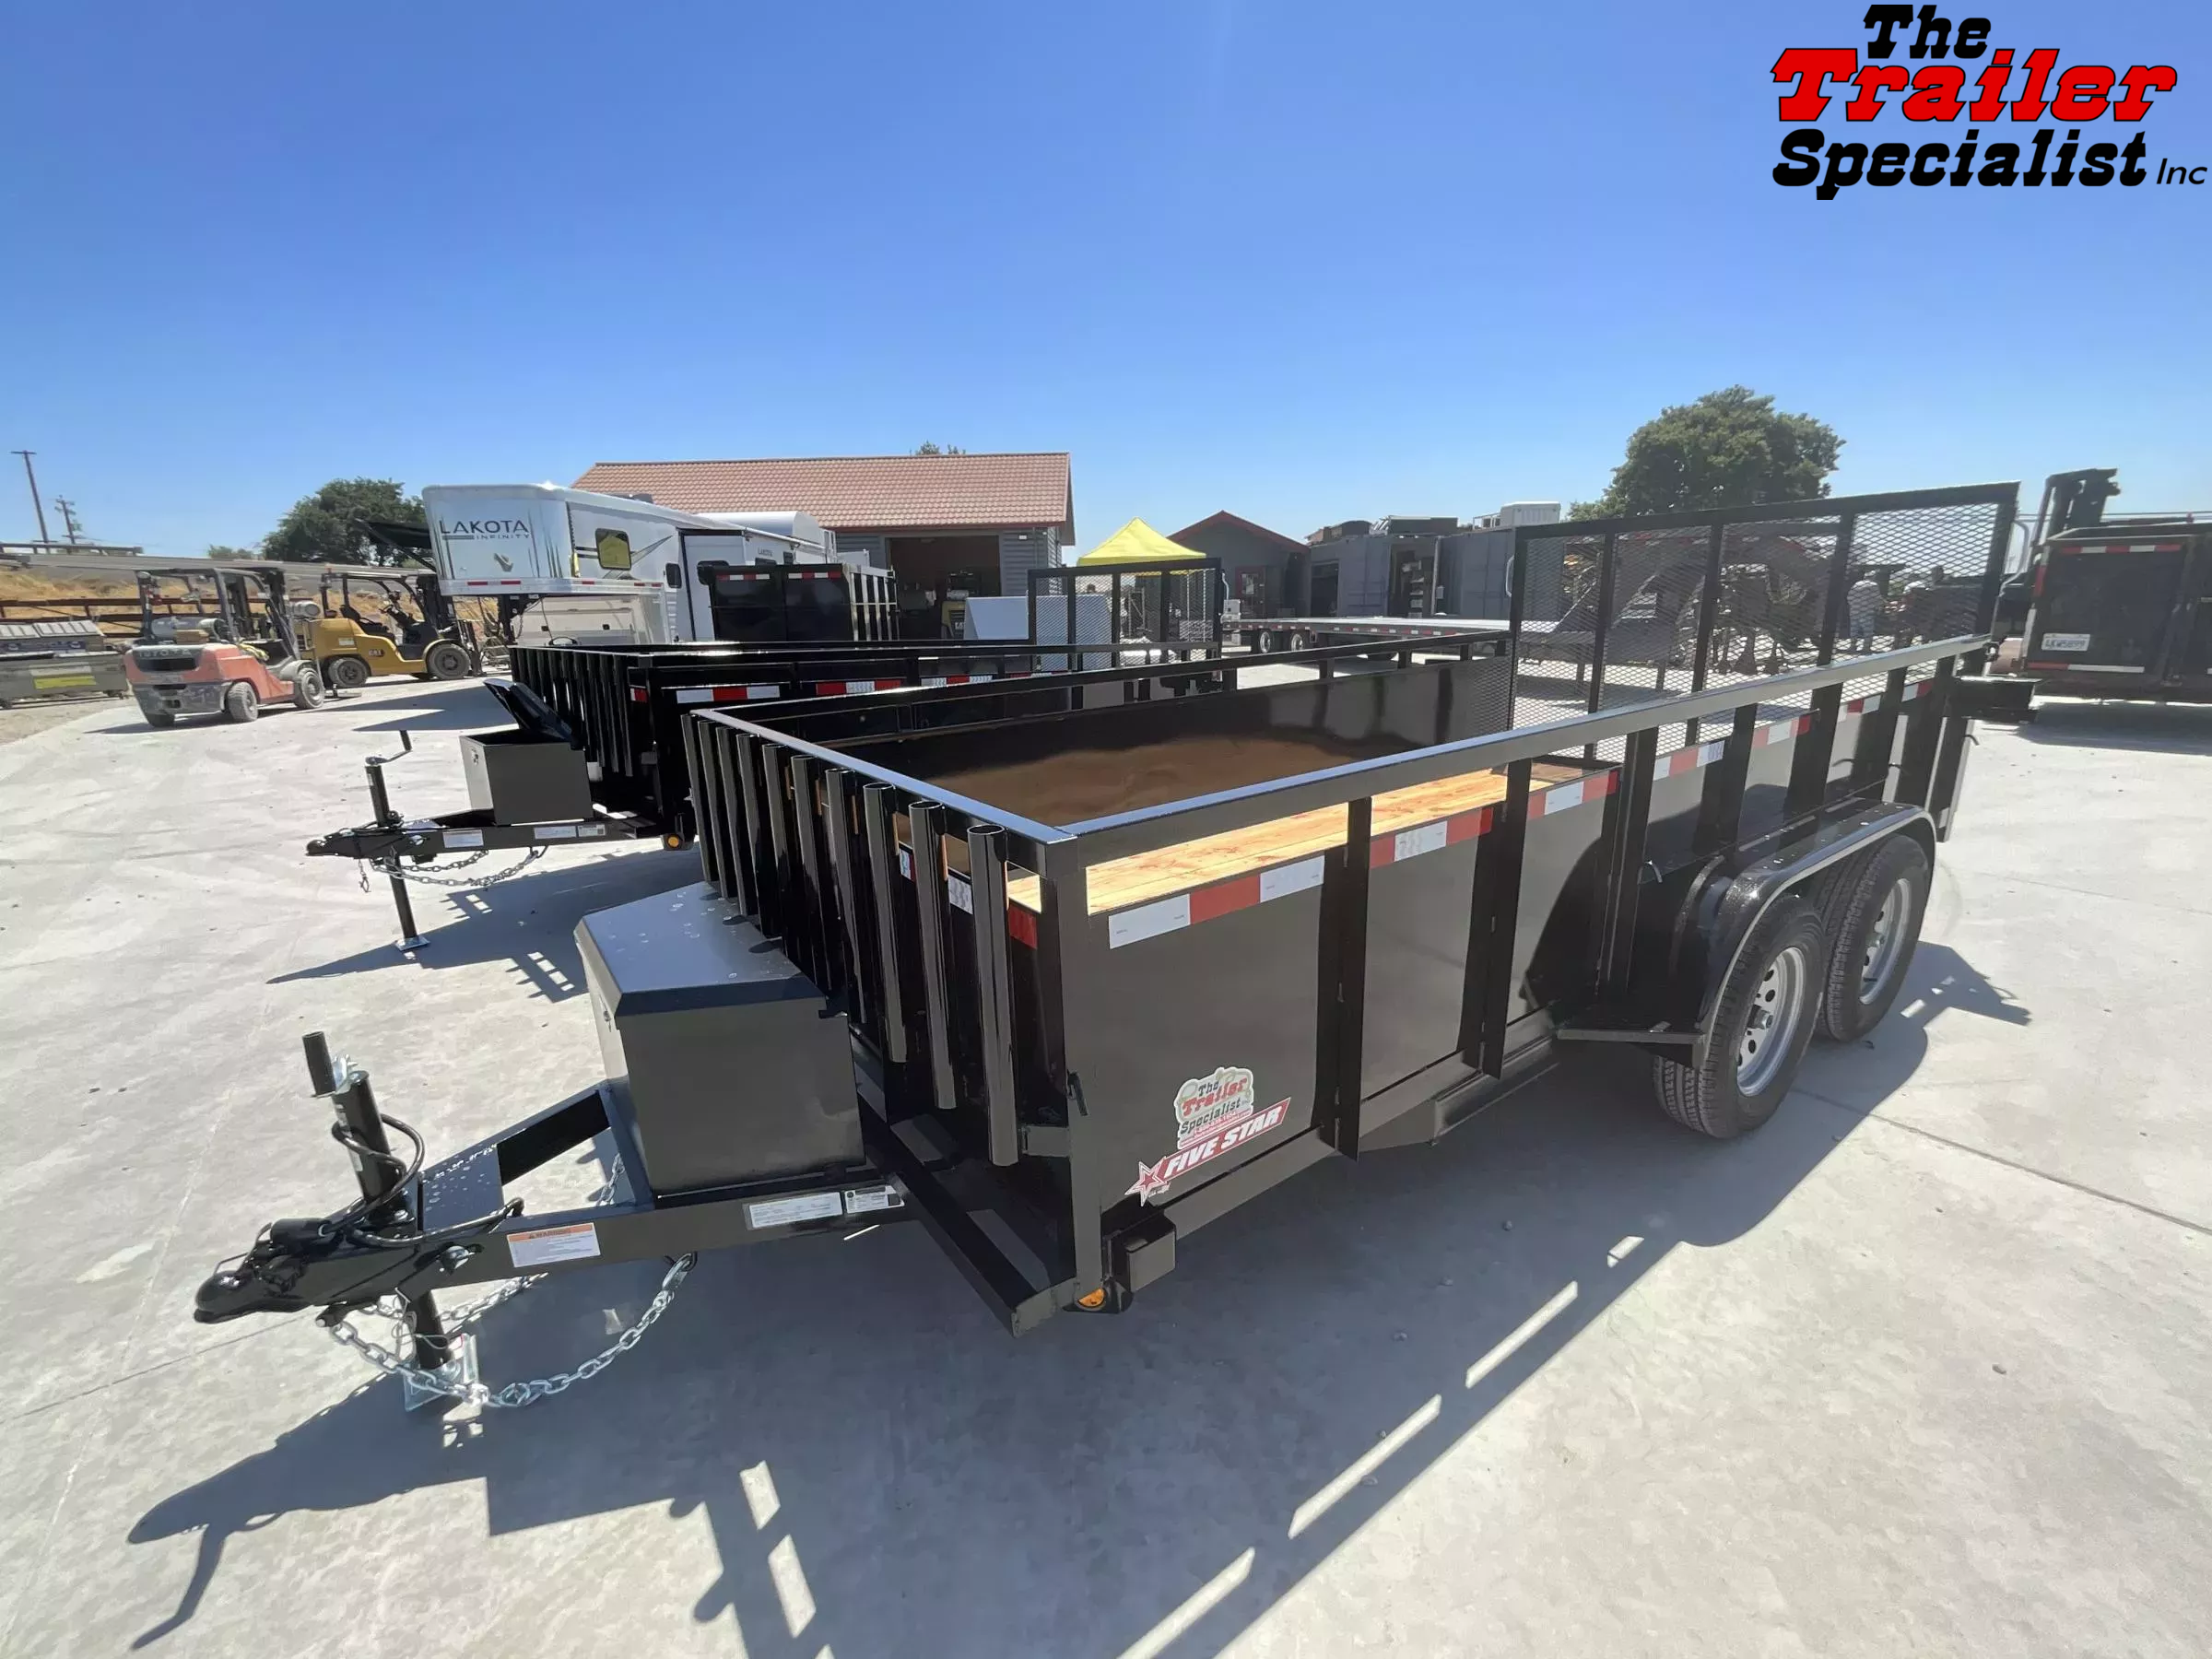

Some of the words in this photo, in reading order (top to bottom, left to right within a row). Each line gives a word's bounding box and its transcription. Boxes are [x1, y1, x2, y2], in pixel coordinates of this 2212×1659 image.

[439, 520, 530, 534] LAKOTA
[1182, 1077, 1248, 1117] Trailer
[1198, 1080, 1219, 1096] The
[1180, 1097, 1241, 1135] Specialist
[1163, 1137, 1219, 1178] FIVE
[1221, 1106, 1283, 1149] STAR
